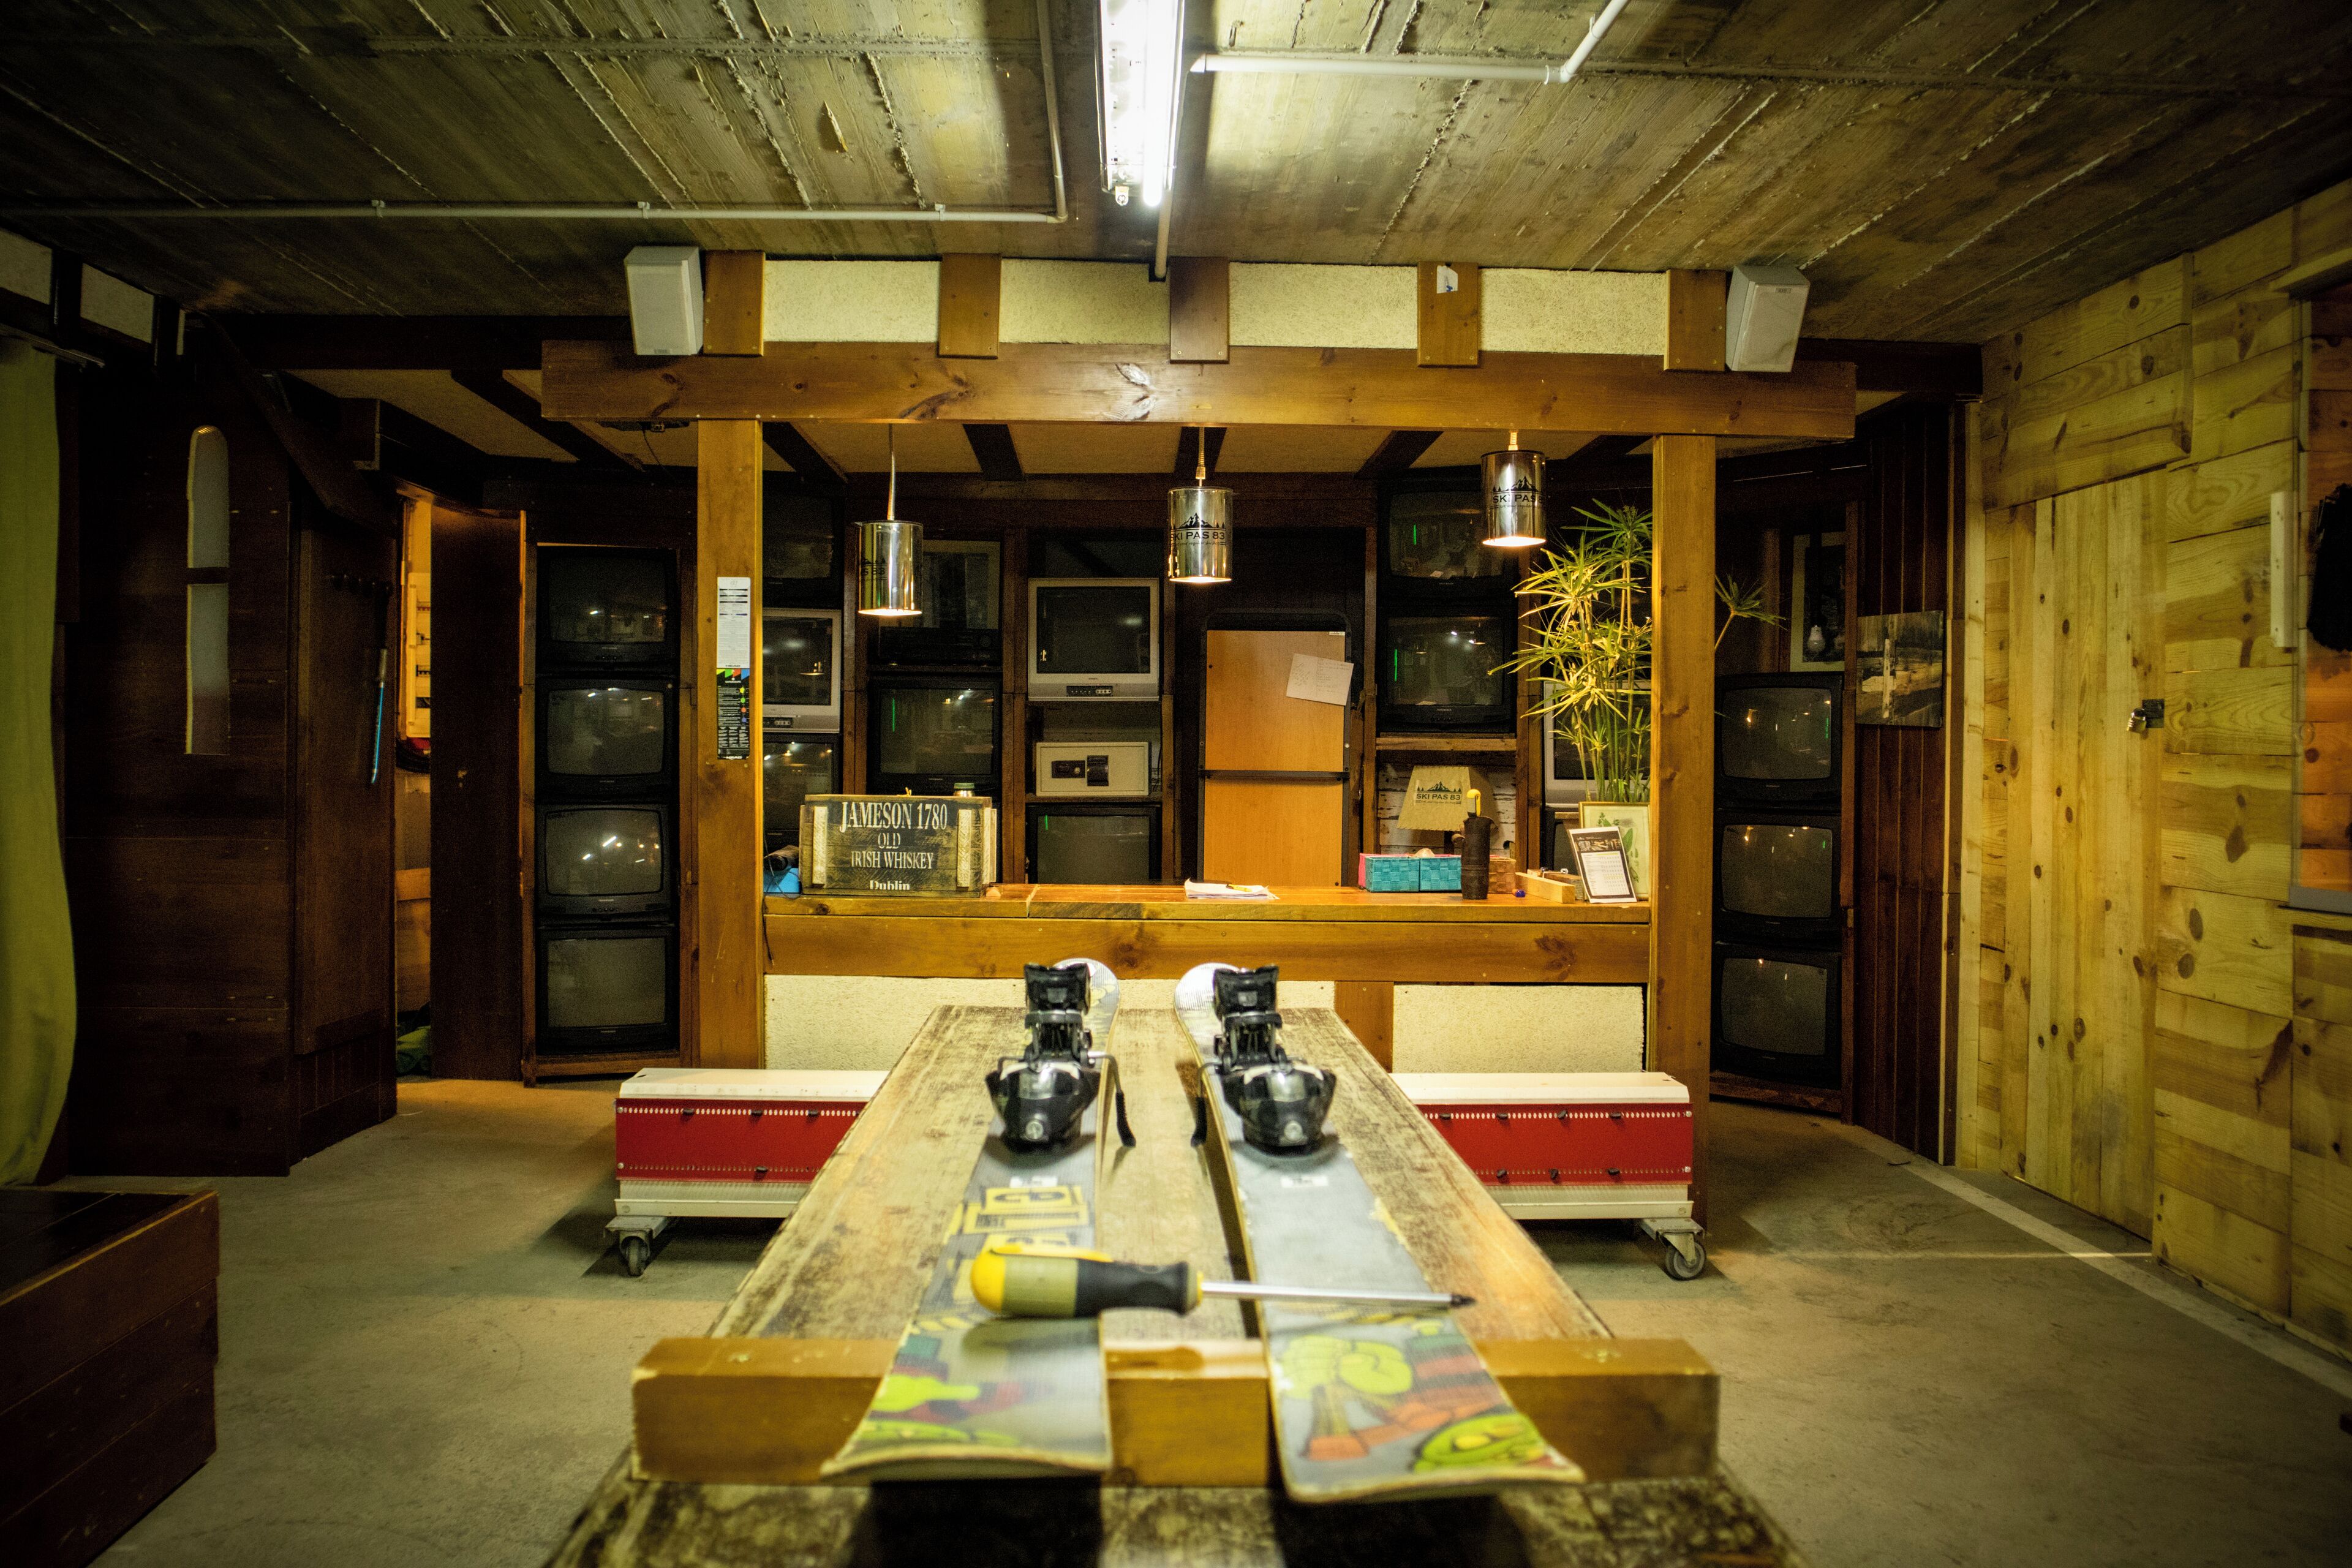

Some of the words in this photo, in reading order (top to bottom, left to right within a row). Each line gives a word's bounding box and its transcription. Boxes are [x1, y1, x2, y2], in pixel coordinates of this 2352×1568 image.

[839, 801, 913, 833] JAMESON
[917, 803, 948, 830] 1780
[878, 832, 901, 849] OLD
[851, 851, 881, 868] IRISH
[884, 851, 933, 869] WHISKEY
[870, 880, 910, 891] Dublin
